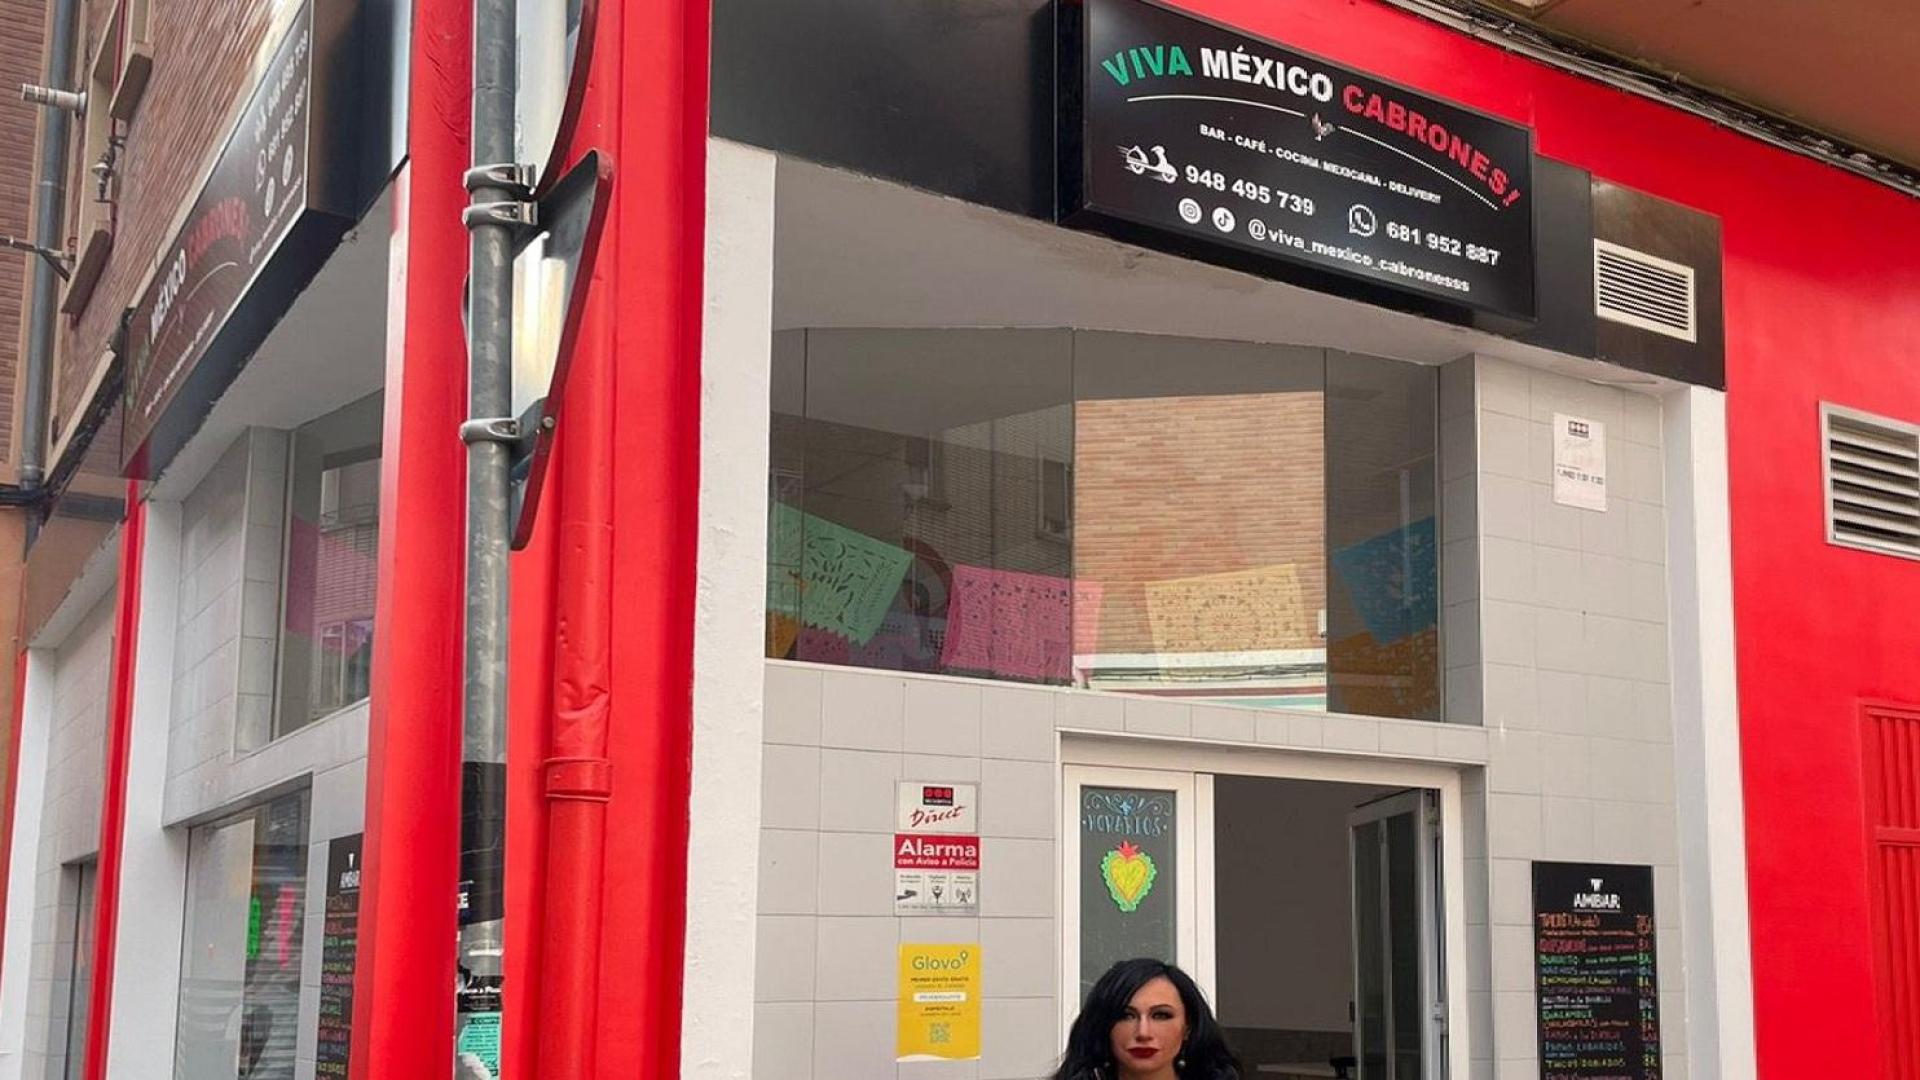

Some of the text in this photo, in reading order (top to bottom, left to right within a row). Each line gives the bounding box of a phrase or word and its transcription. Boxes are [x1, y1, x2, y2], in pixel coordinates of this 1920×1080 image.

[1102, 45, 1521, 206] VIVA MÉXICO CABRONES!
[1199, 123, 1226, 142] BAR
[1234, 135, 1267, 154] CAFÉ
[1185, 164, 1315, 216] 948 495 739
[1386, 221, 1421, 245] 681
[1425, 232, 1462, 256] 952
[911, 805, 966, 828] Direct
[897, 838, 977, 857] Alarma
[916, 857, 939, 866] Aviso
[912, 954, 962, 970] Glovo
